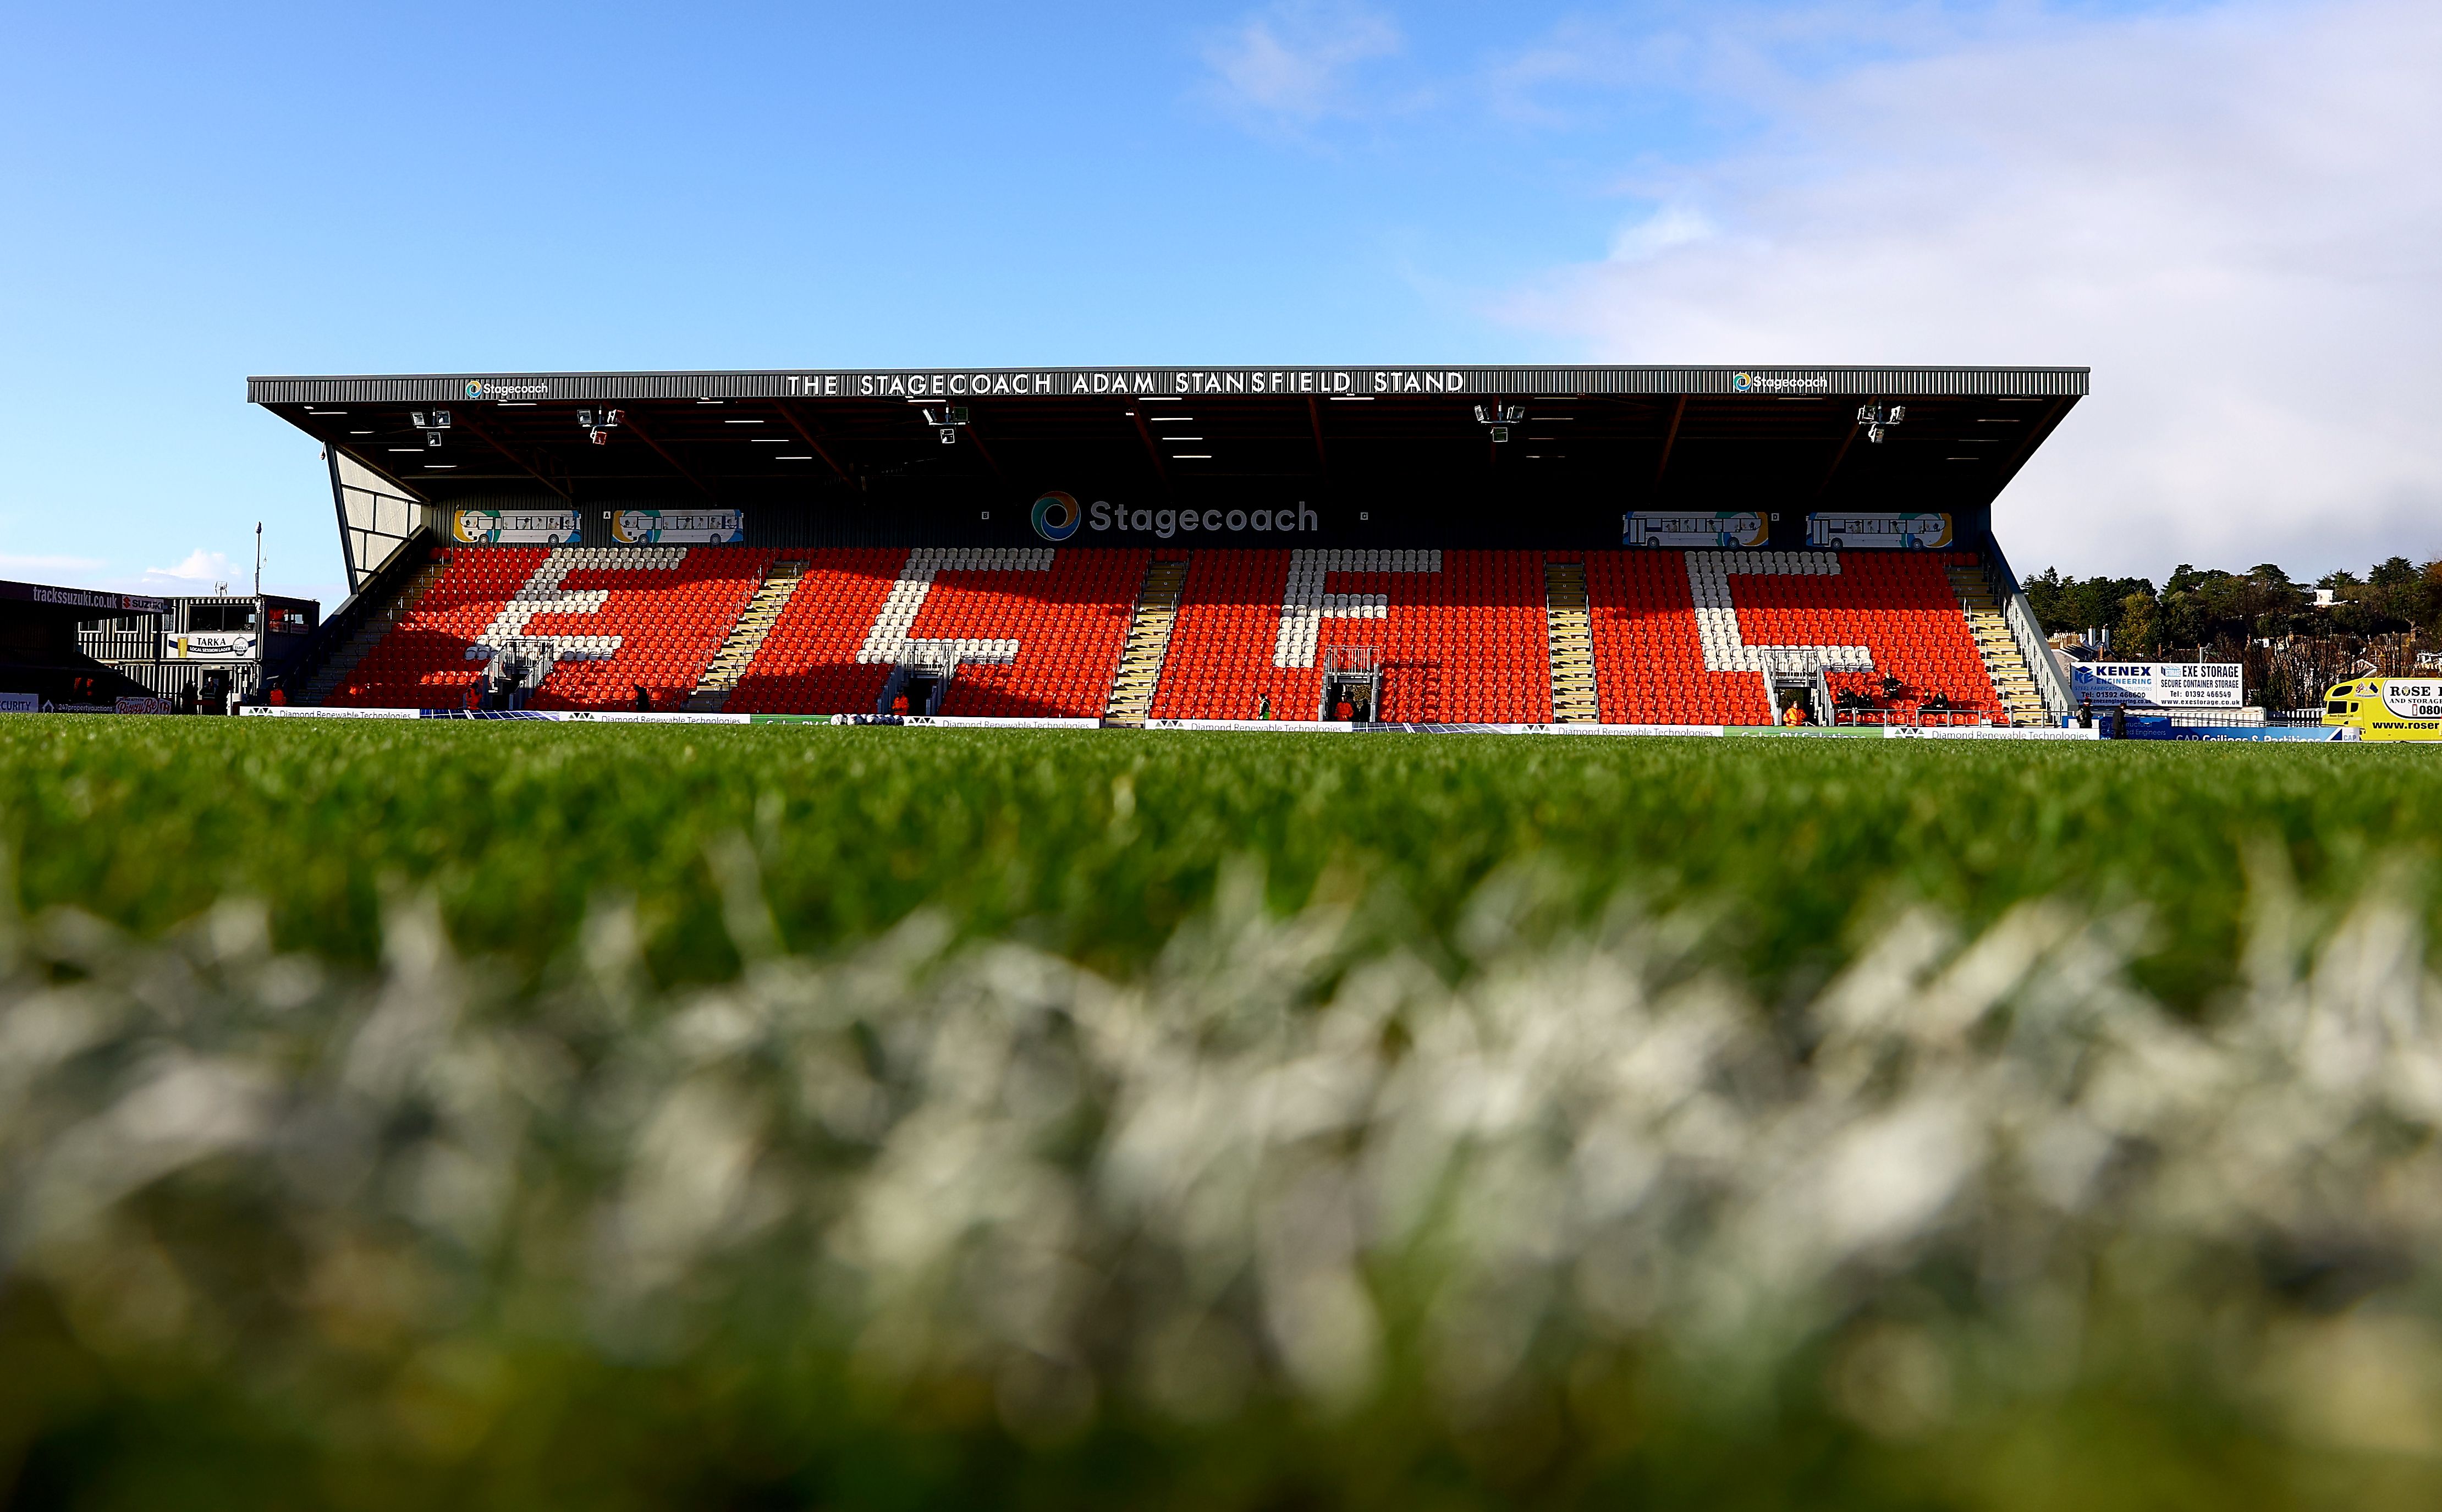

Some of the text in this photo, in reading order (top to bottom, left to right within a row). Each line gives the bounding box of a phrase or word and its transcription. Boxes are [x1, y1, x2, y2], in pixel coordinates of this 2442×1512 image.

[788, 371, 1464, 394] THE STAGECOACH ADAM STANSFIELD STAND
[1753, 376, 1828, 390] Stagecoach
[483, 382, 548, 396] Stagecoach
[1089, 501, 1318, 538] Stagecoach
[33, 586, 117, 608] trackssuzuki.co.uk
[132, 600, 163, 610] SUZUKI
[197, 637, 226, 646] TARKA
[2096, 666, 2151, 676] KENEX
[2182, 666, 2238, 677] EXE STORAGE
[2160, 679, 2181, 688] SECURE
[2215, 680, 2239, 688] STORAGE
[2390, 686, 2430, 696] ROSE
[58, 704, 113, 712] 247propertyauctions
[2419, 705, 2442, 714] 080
[1932, 730, 2089, 740] Diamond Renewable Technologies
